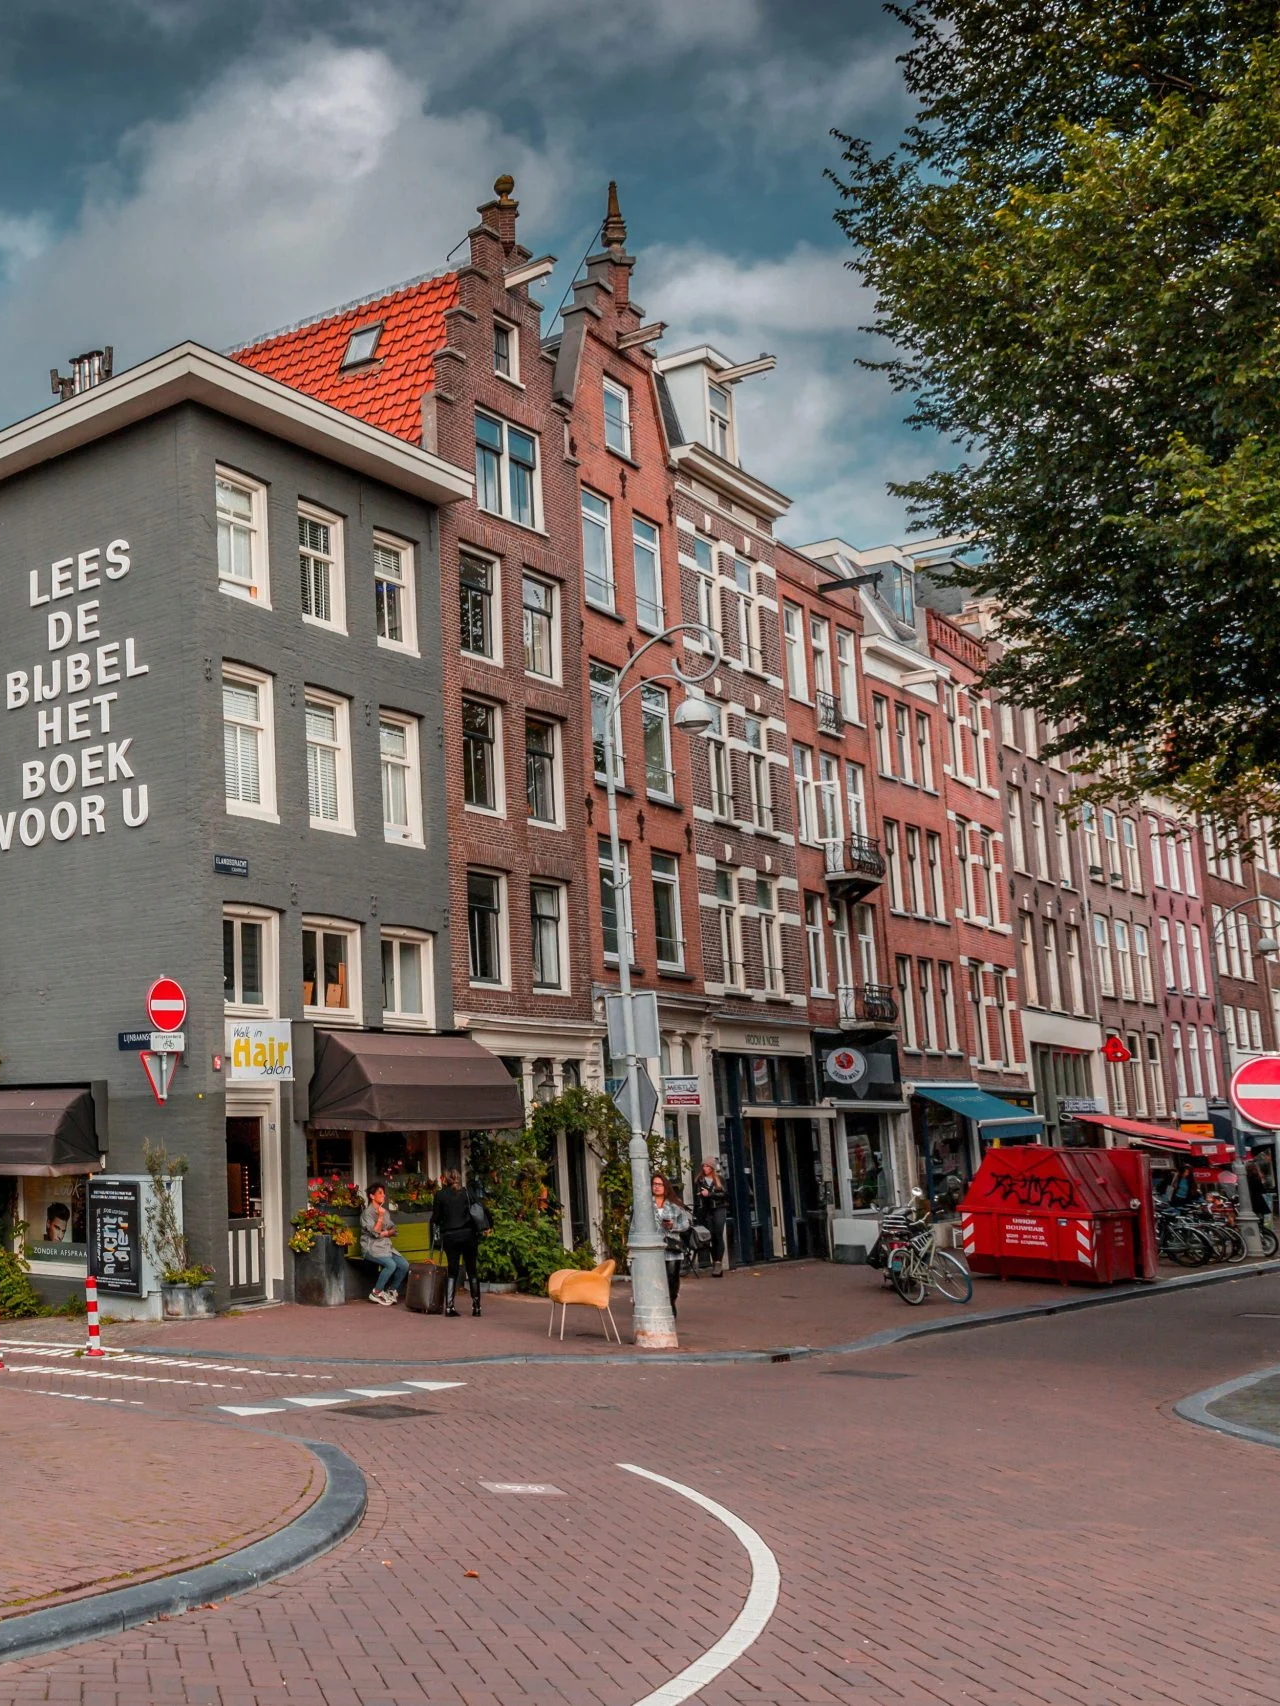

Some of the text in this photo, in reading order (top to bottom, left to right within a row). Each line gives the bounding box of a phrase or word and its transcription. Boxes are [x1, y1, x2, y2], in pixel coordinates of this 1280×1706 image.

[29, 538, 131, 608] LEES
[47, 600, 100, 651] DE
[6, 637, 150, 711] BIJBEL
[37, 691, 118, 749] HET
[22, 738, 135, 801] BOEK
[122, 784, 150, 828] U
[233, 1026, 263, 1039] Walk in
[233, 1036, 289, 1068] Hair
[260, 1059, 292, 1075] Salon
[33, 1246, 88, 1258] ZONDER AFSPRAA
